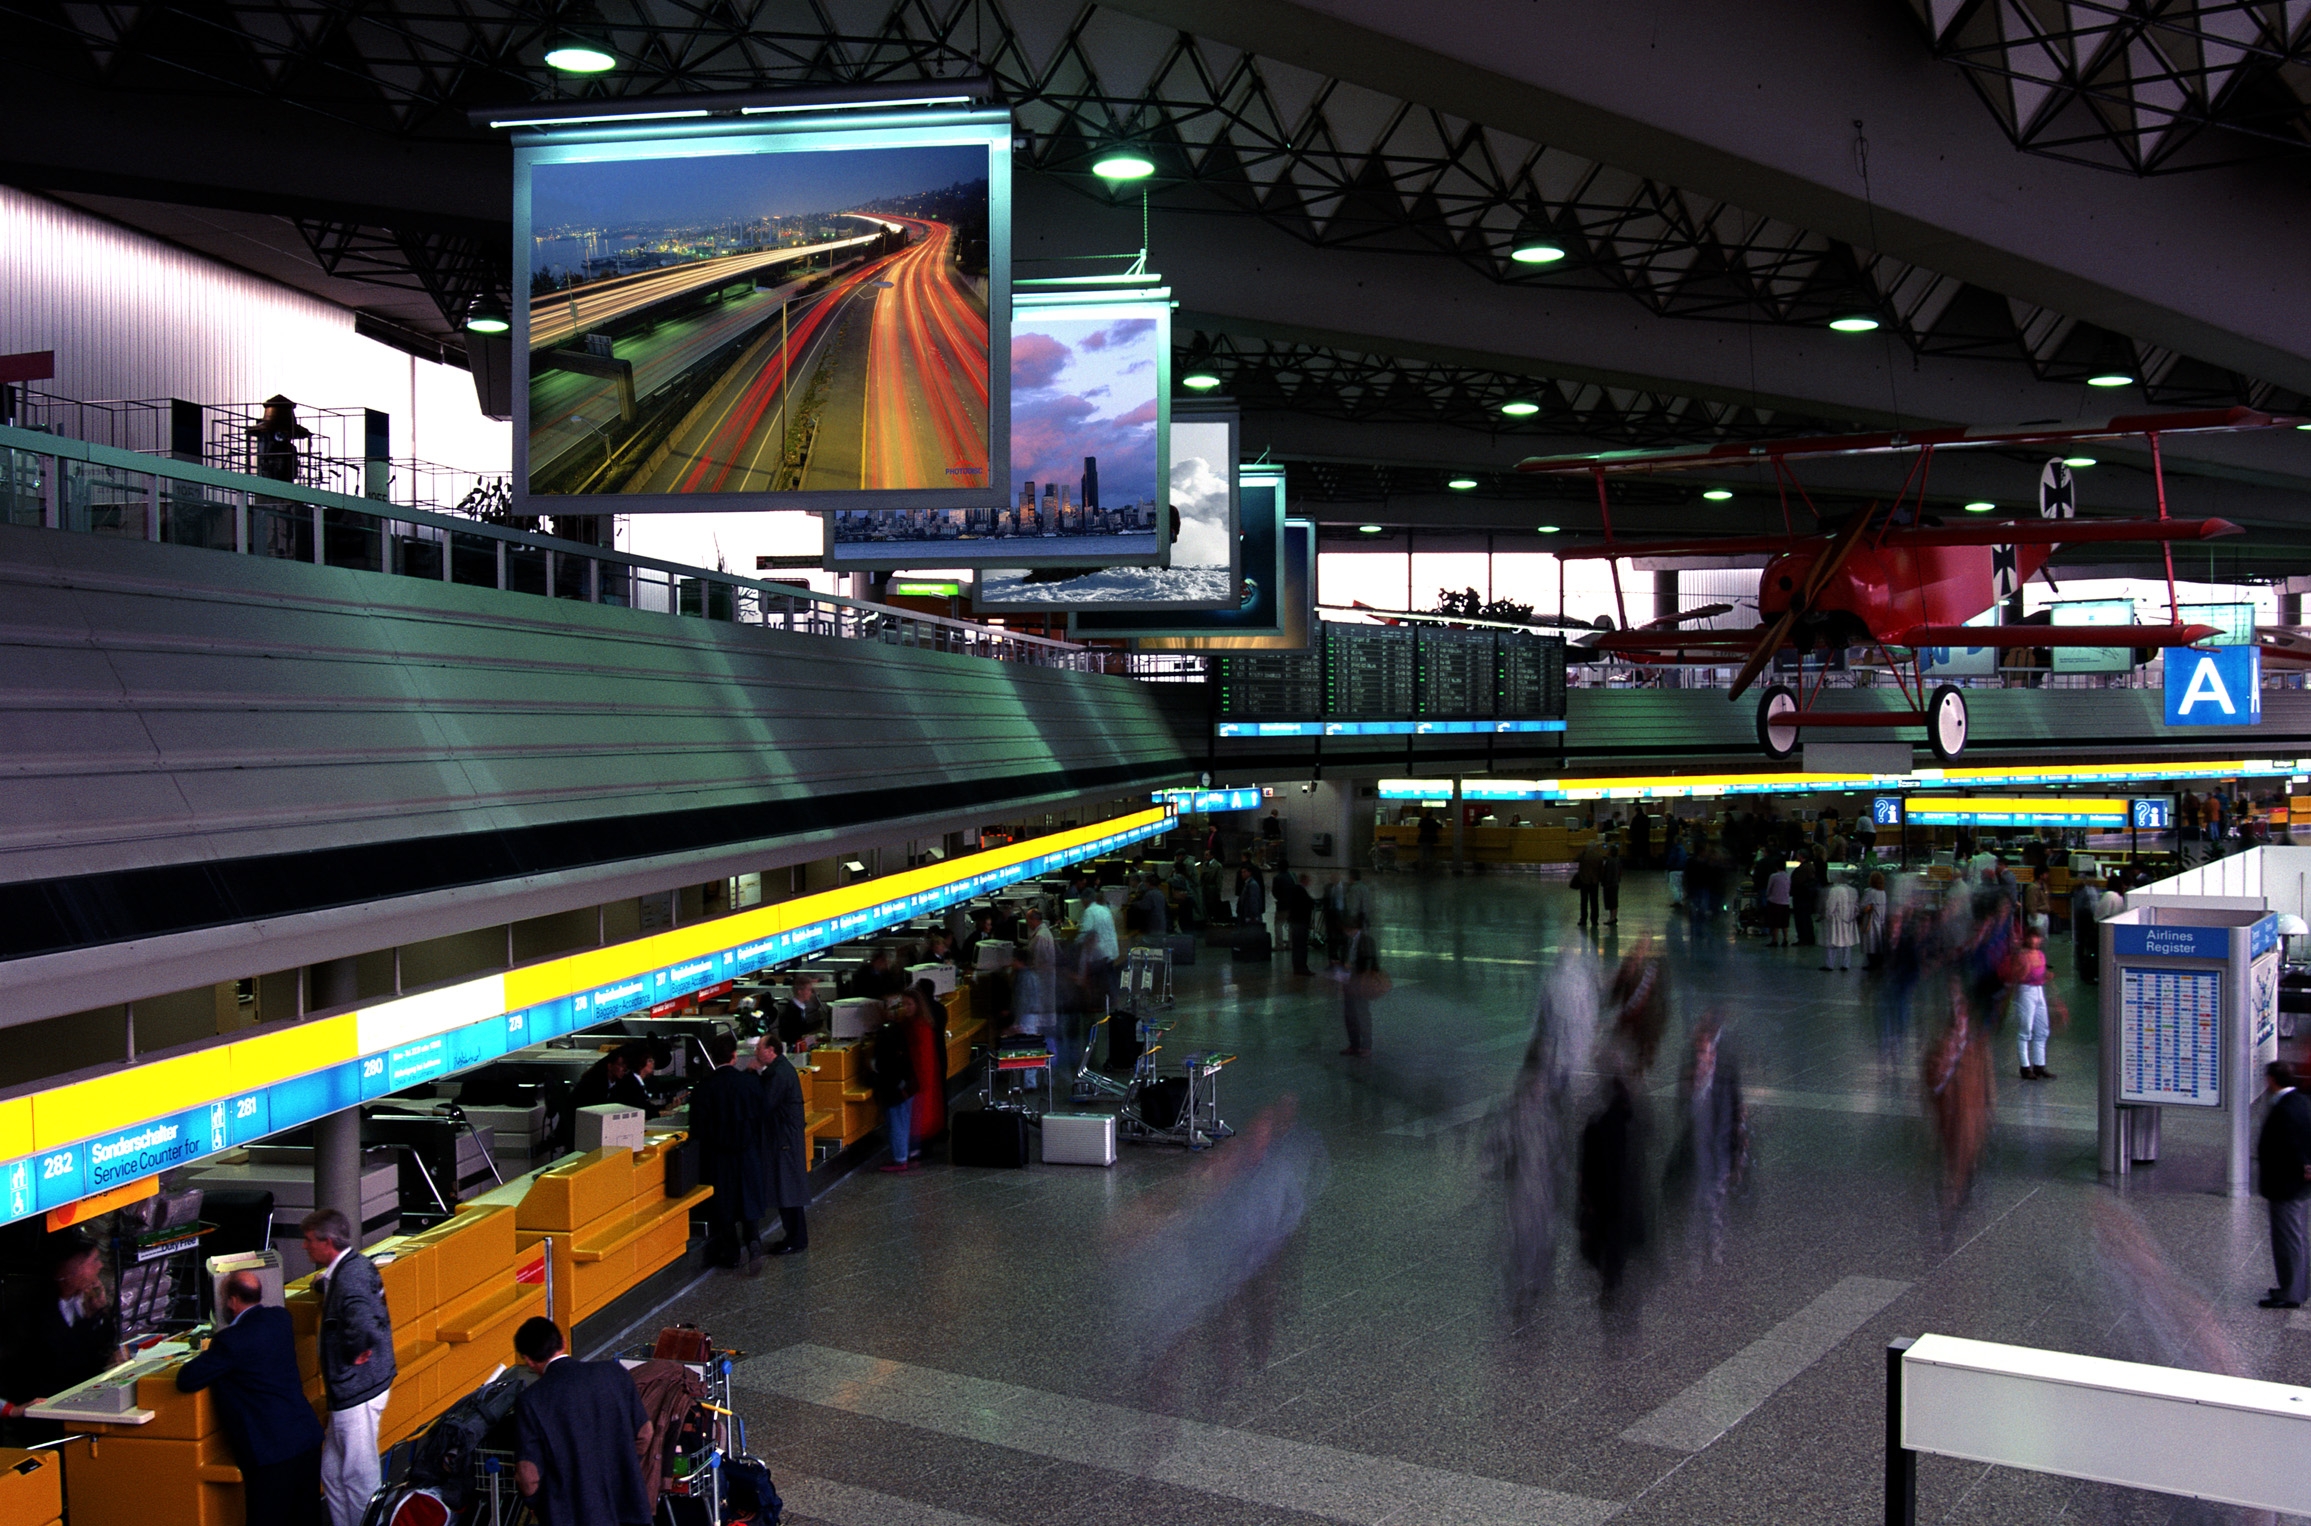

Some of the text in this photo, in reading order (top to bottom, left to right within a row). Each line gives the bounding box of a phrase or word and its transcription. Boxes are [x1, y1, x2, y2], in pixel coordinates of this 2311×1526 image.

[2178, 657, 2236, 715] A
[2250, 657, 2260, 713] A
[2146, 930, 2193, 942] Airlines
[2146, 941, 2196, 955] Register
[363, 1058, 383, 1078] 280
[237, 1096, 257, 1118] 281
[92, 1124, 178, 1164] Sonderschalter
[44, 1152, 73, 1179] 282
[94, 1138, 200, 1185] Service Counter for
